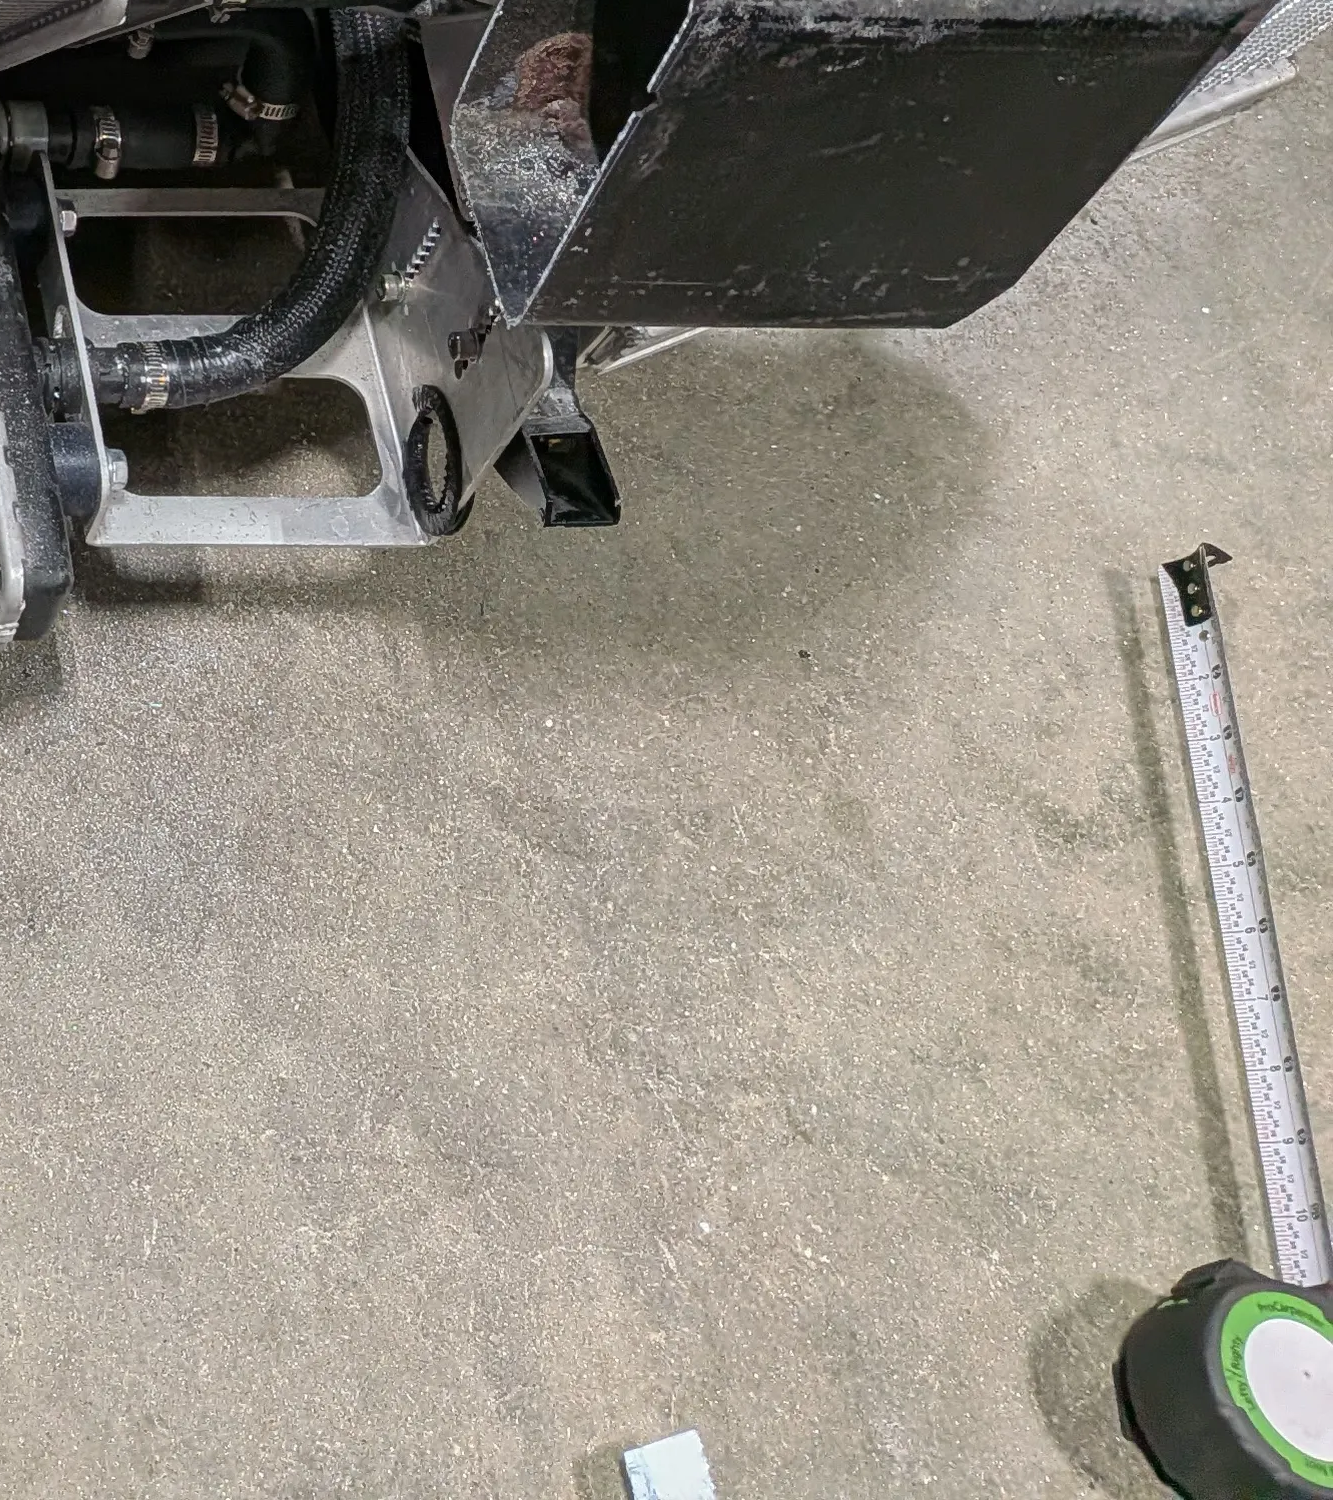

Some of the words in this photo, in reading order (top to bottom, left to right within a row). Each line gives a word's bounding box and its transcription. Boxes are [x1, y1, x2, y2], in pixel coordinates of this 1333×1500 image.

[1199, 673, 1210, 682] 2
[1210, 734, 1221, 742] 3
[1221, 796, 1233, 804] 4
[1233, 860, 1244, 868] 5
[1245, 927, 1257, 935] 6
[1270, 1065, 1282, 1073] 8
[1282, 1138, 1294, 1146] 9
[1295, 1208, 1309, 1223] 10
